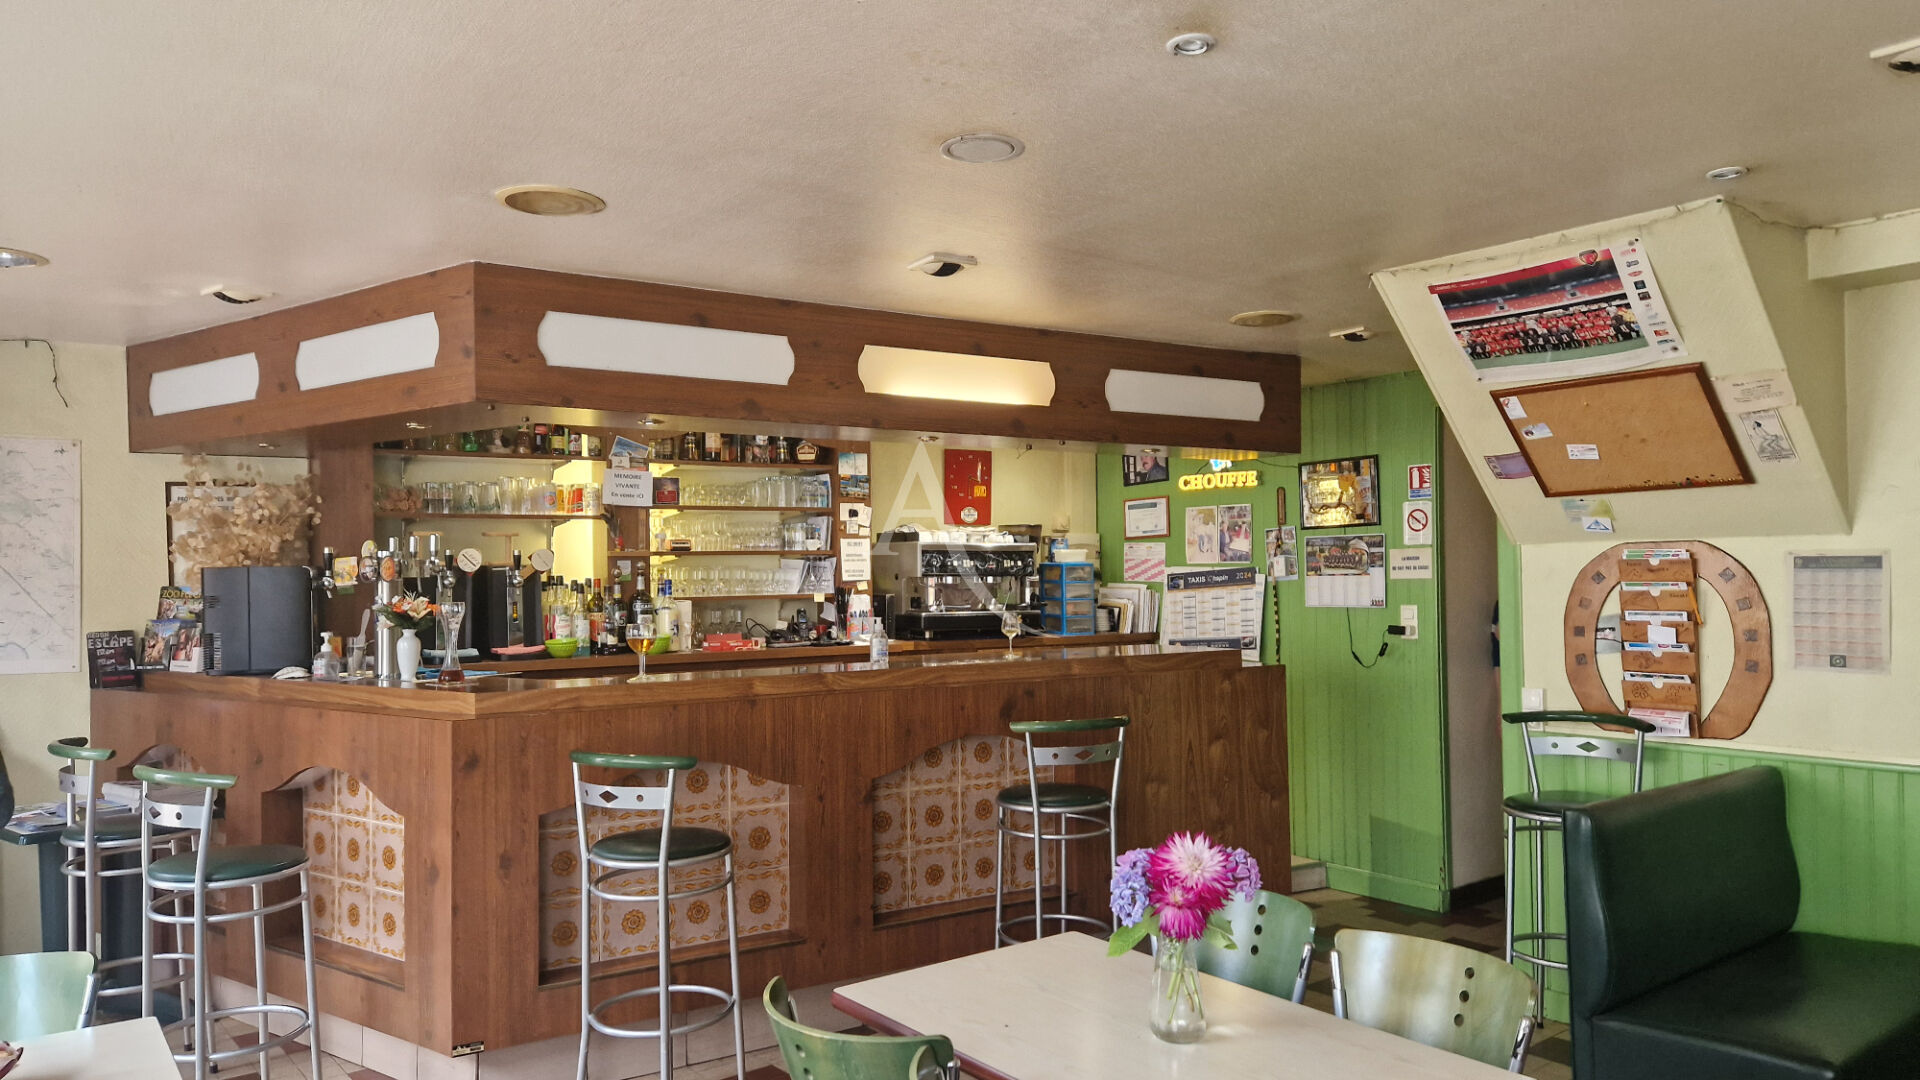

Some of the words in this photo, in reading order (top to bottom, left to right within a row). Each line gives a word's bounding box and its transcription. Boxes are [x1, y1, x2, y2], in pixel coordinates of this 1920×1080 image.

[1178, 470, 1258, 491] CHOUFFE
[1187, 576, 1206, 584] TAXIS
[1235, 572, 1252, 580] 2024
[162, 589, 180, 598] ZOO
[88, 634, 134, 649] ESCAPE
